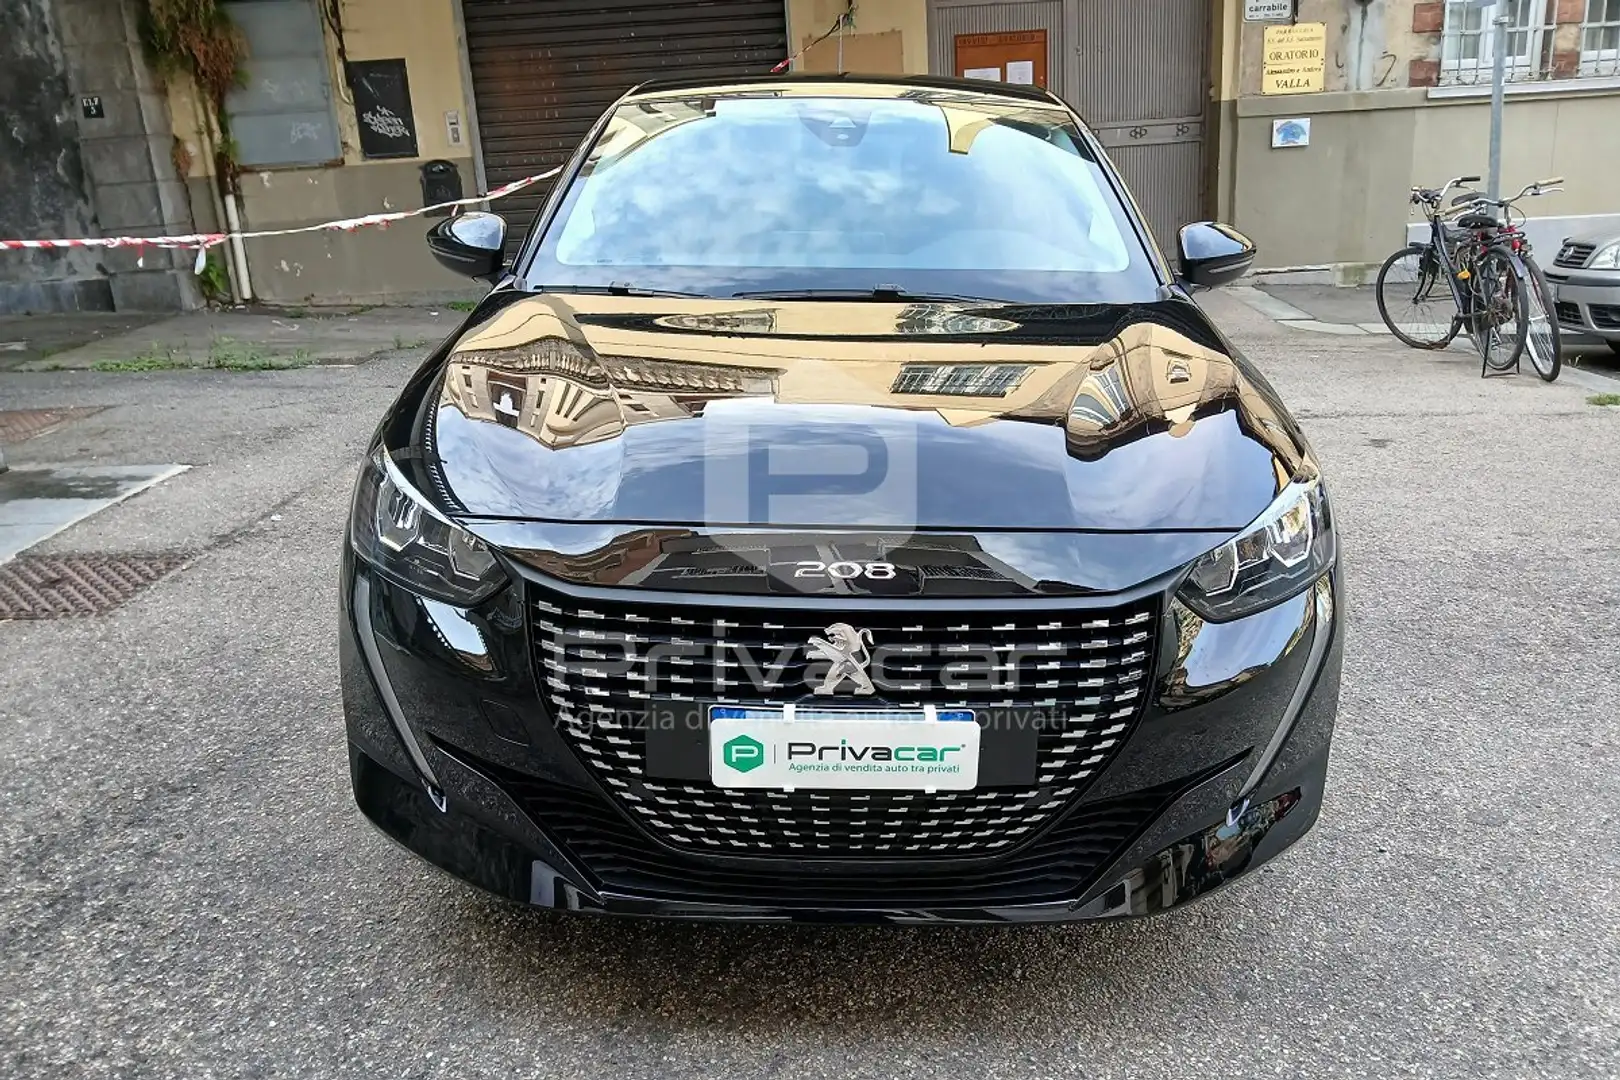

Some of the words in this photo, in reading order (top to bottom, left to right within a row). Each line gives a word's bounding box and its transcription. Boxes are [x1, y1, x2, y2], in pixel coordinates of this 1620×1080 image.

[1248, 3, 1288, 12] carrabile
[1268, 49, 1319, 61] ORATORIO
[1275, 79, 1310, 89] VALLA
[794, 561, 896, 579] 208
[788, 739, 960, 762] Privacar
[788, 763, 830, 773] Agenzia
[832, 763, 842, 772] di
[844, 764, 882, 772] vendita
[927, 765, 960, 774] privati
